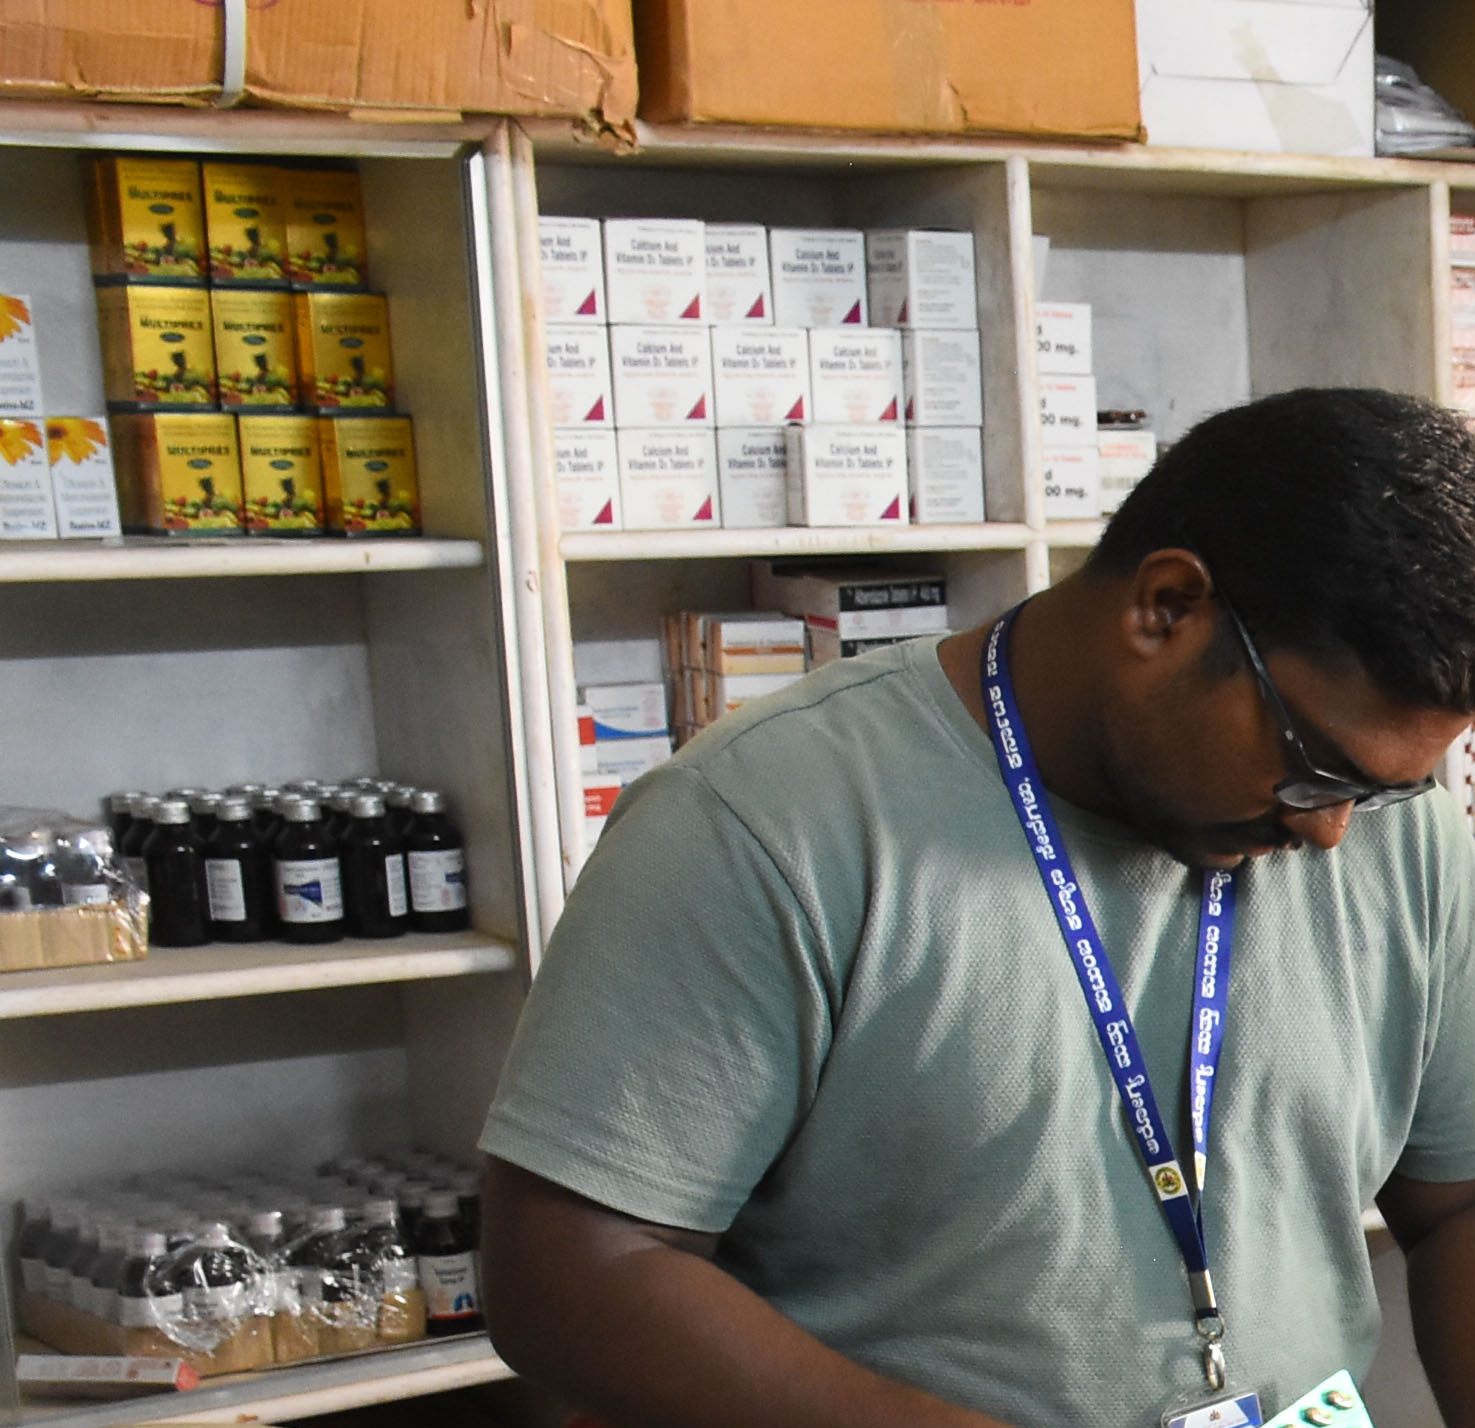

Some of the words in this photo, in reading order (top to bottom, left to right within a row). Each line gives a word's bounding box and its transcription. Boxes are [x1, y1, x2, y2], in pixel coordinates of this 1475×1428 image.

[1065, 487, 1088, 498] mg.
[989, 685, 1023, 770] ಕರ್ನಾಟಕ
[1051, 869, 1082, 931] ಕಲ್ಯಾಣ
[1077, 938, 1112, 1014] ಕುಟುಂಬ
[1201, 925, 1219, 999] ಕುಟುಂಬ
[1105, 1019, 1131, 1069] ಮತ್ತು
[1198, 1007, 1219, 1055] ಮತ್ತು
[1126, 1074, 1160, 1155] ಆರೋಗ್ಯ
